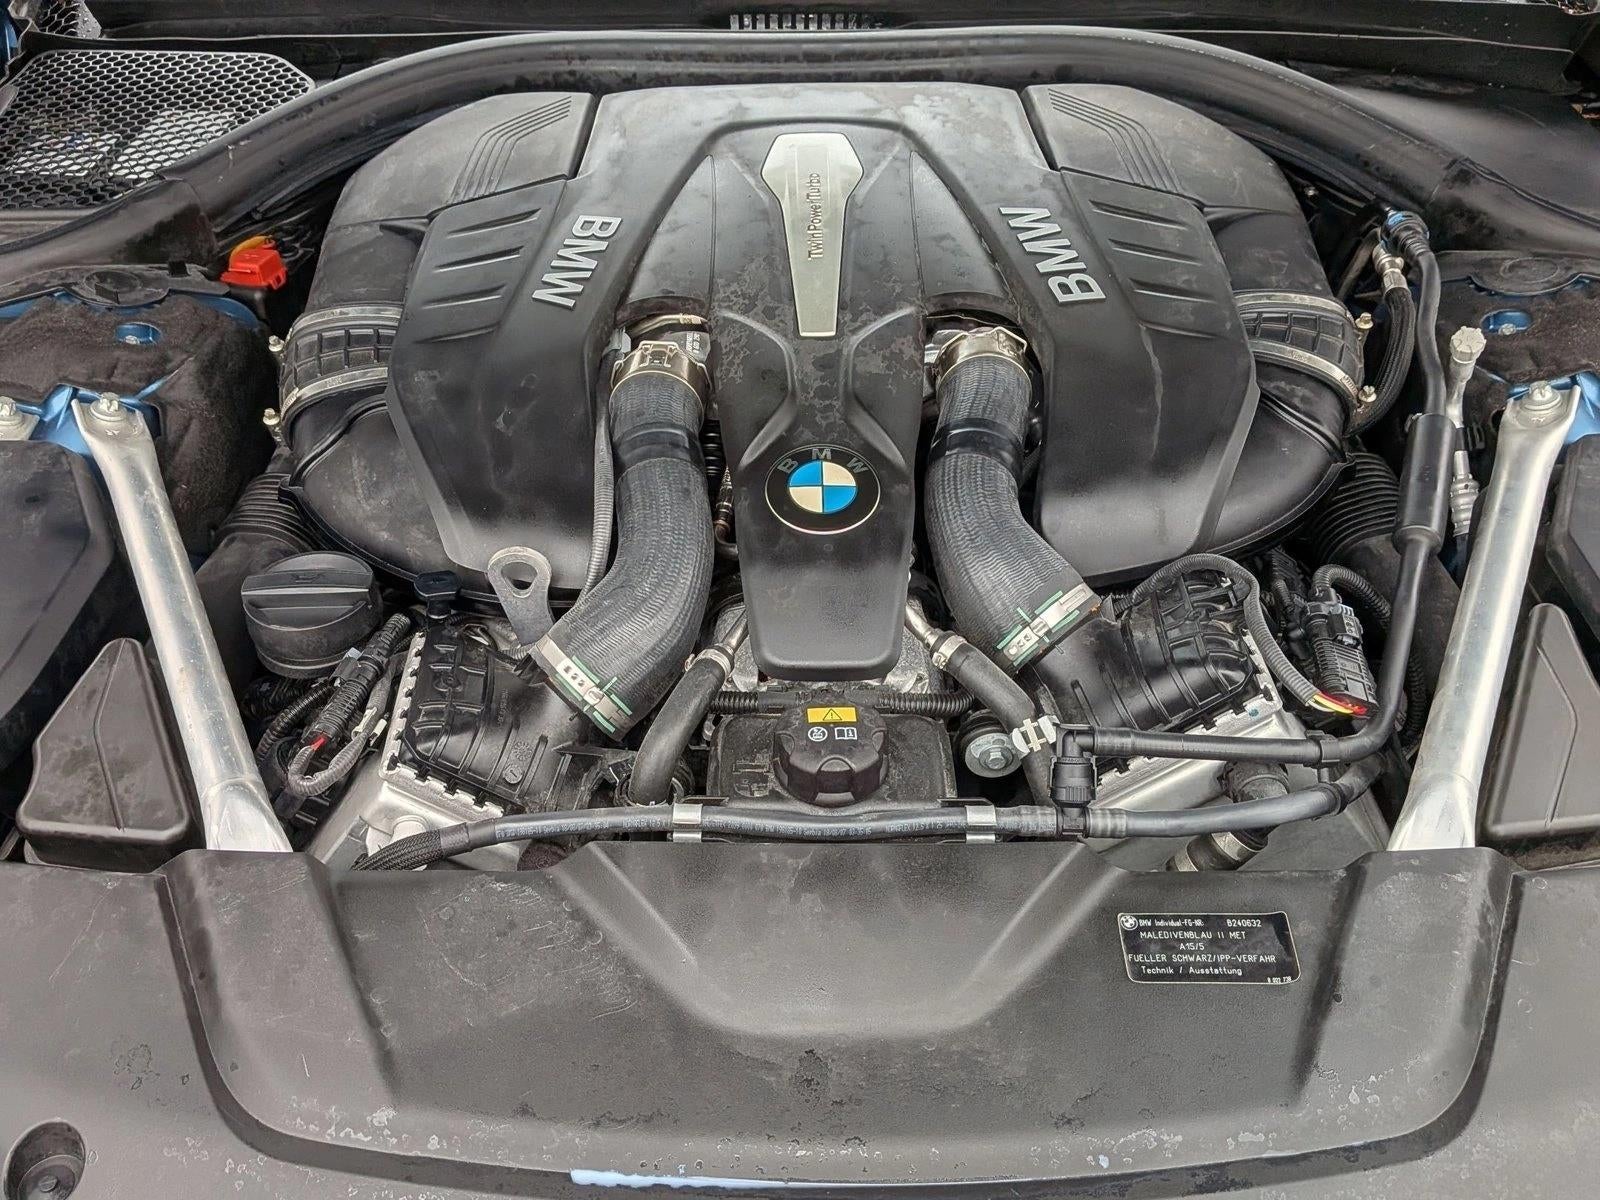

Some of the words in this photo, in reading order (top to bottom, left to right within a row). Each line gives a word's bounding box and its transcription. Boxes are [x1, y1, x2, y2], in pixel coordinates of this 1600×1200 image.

[807, 172, 823, 260] TwinPowerTurbo
[532, 215, 622, 309] BMW
[999, 207, 1106, 303] BMW
[777, 447, 869, 474] BMW
[1140, 931, 1213, 939] MALEDIVENBLAU
[1229, 931, 1246, 939] MET
[1179, 943, 1205, 951] A15/5
[1128, 954, 1167, 962] FUELLER
[1141, 965, 1174, 974] Technik
[1188, 966, 1243, 976] Ausstattung
